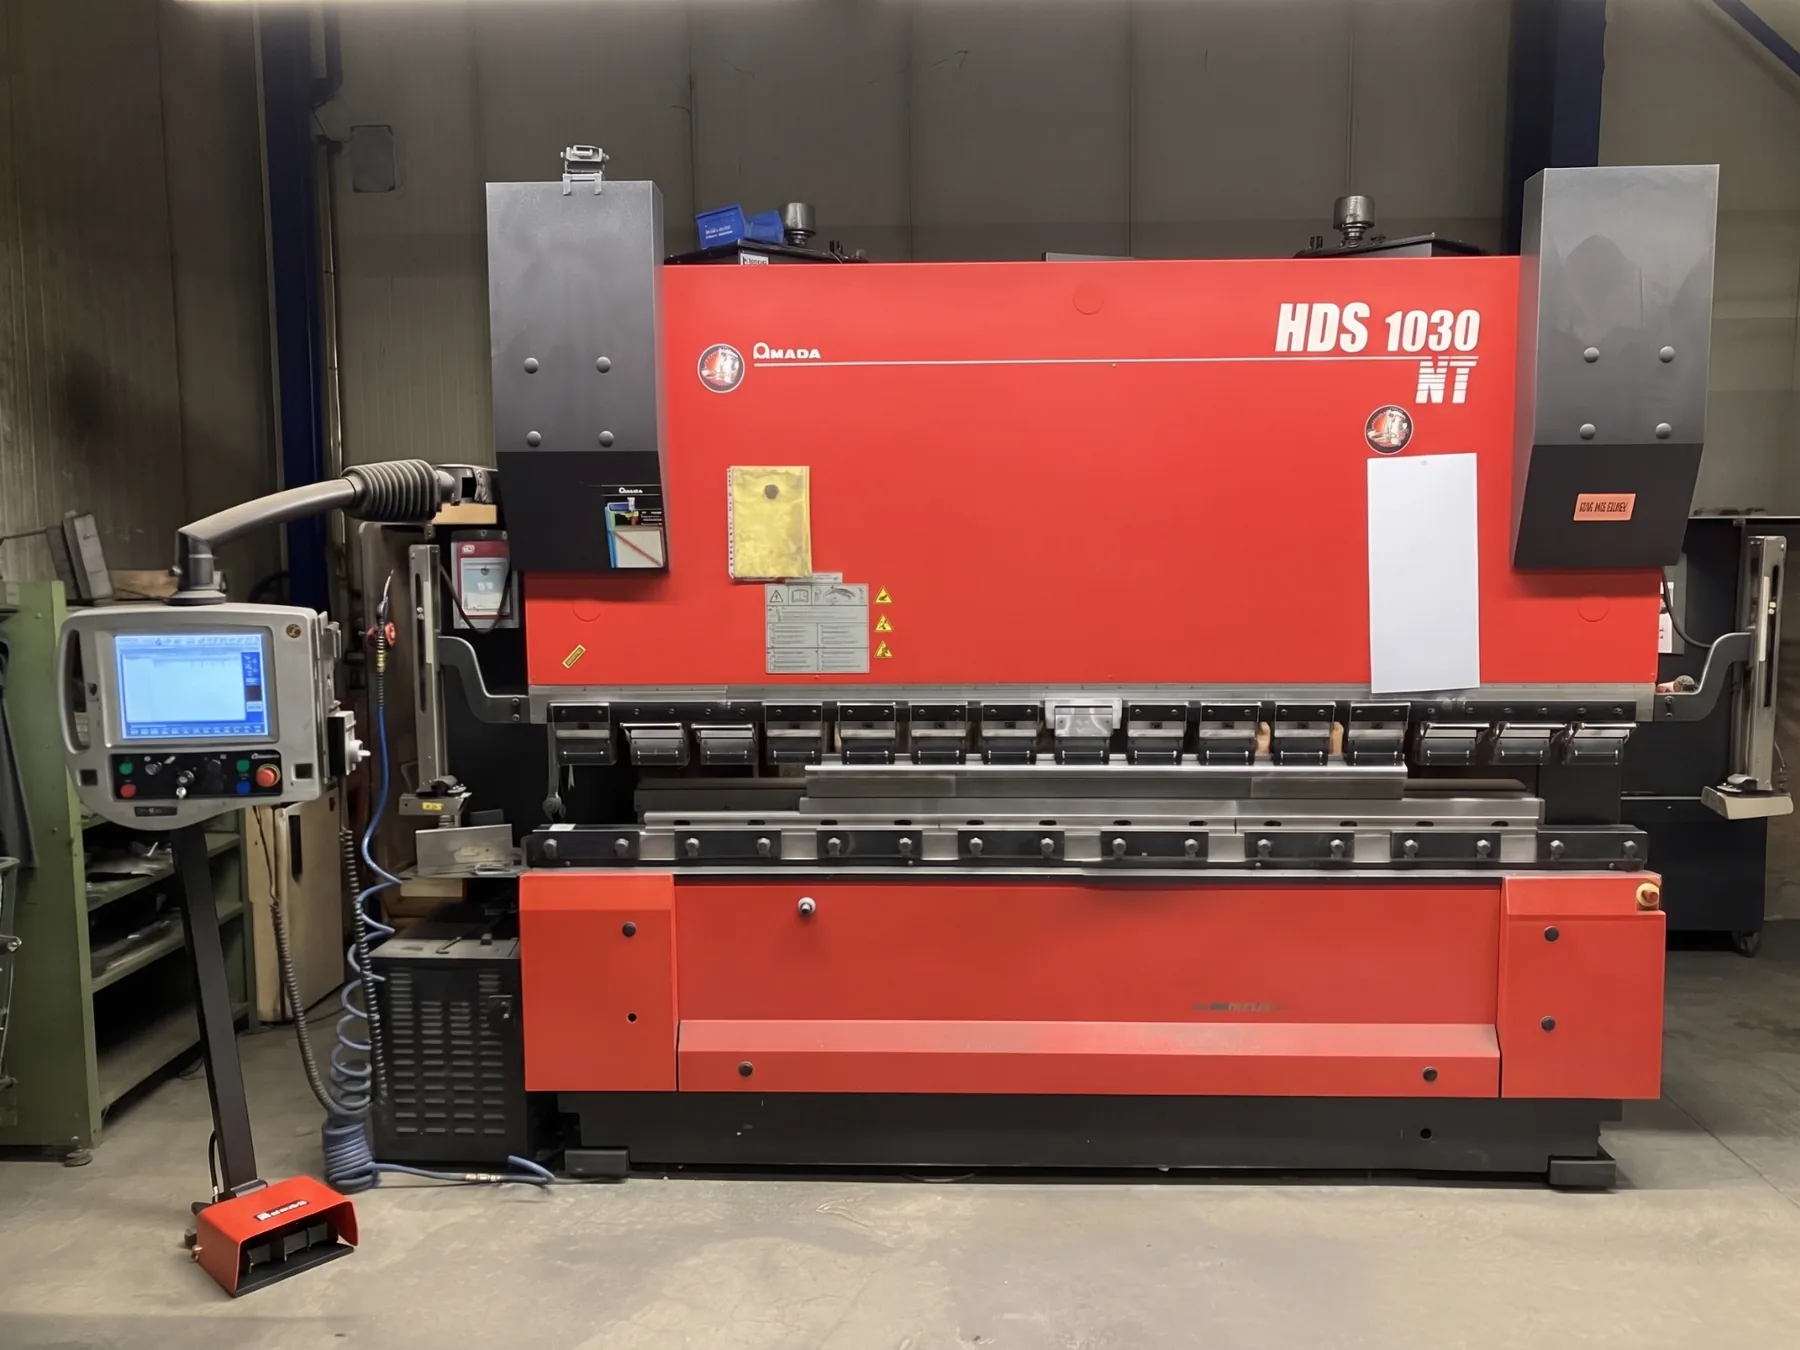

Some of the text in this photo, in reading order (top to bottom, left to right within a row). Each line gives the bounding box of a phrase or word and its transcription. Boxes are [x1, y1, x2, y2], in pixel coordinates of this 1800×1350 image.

[753, 342, 821, 359] AMADA
[1275, 302, 1480, 353] HDS 1030
[1415, 356, 1479, 404] NT
